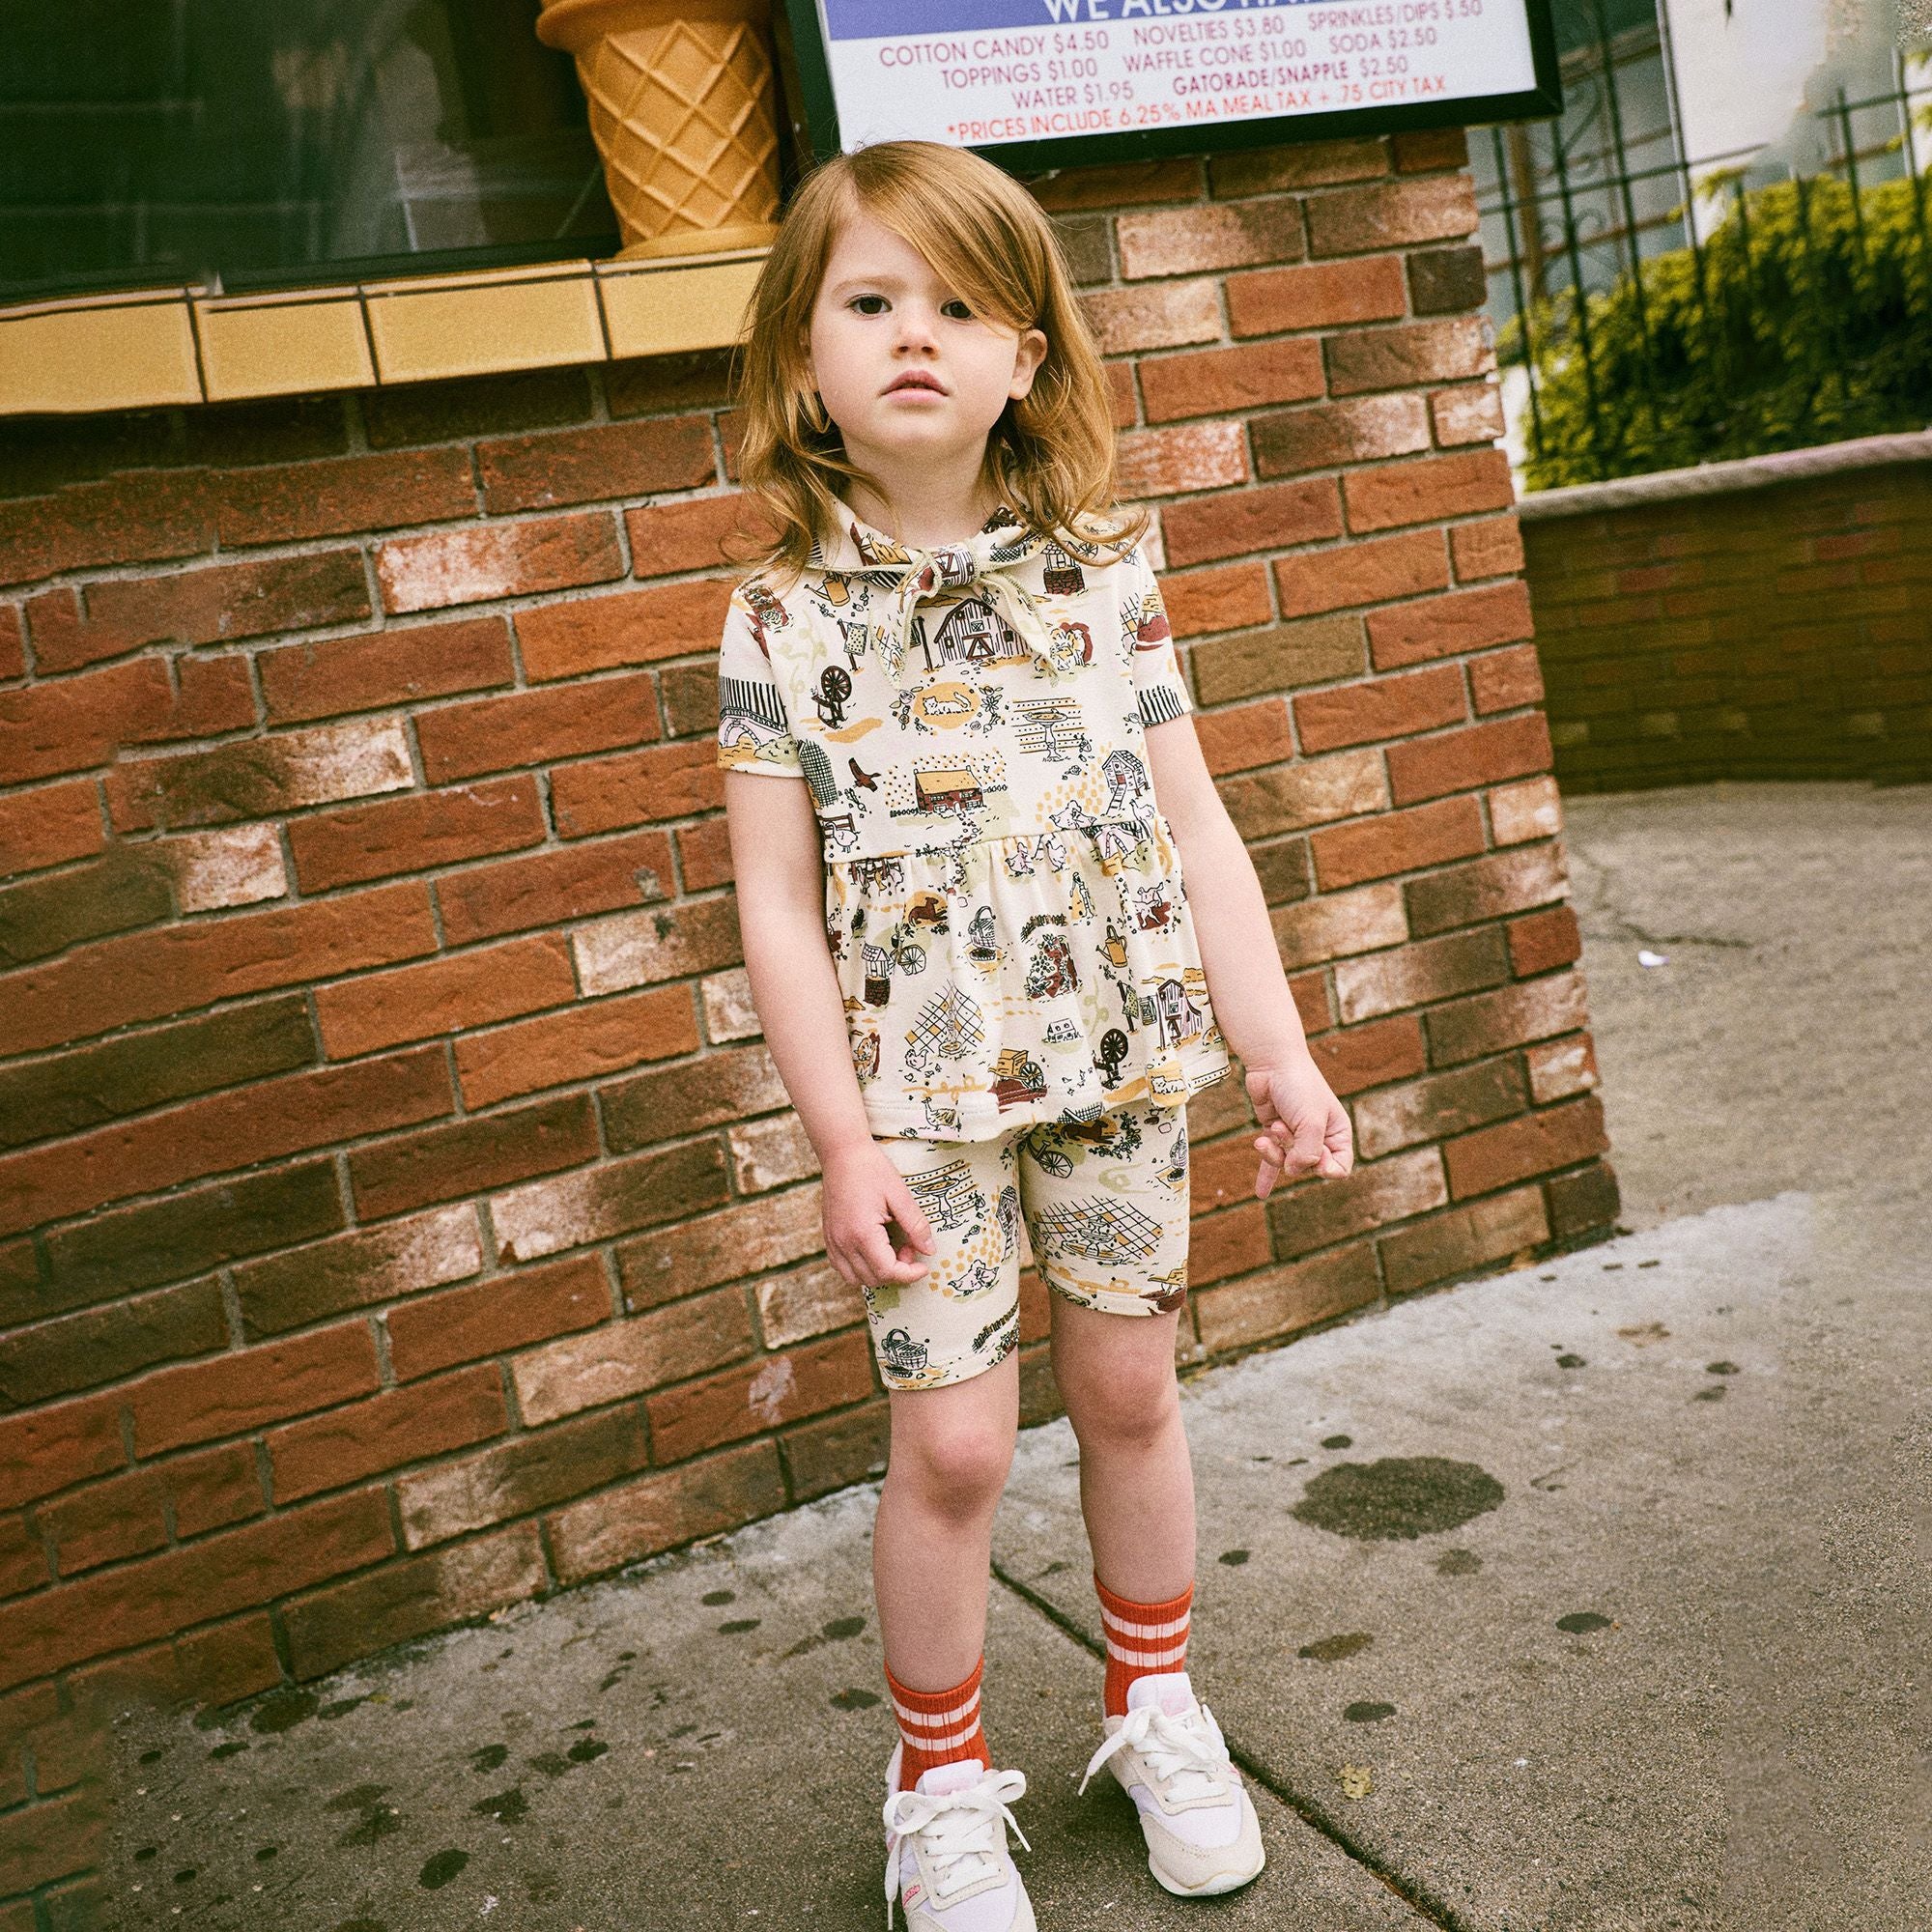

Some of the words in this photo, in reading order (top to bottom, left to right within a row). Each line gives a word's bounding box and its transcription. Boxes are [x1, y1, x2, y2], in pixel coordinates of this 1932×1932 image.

[880, 42, 967, 67] COTTON
[974, 35, 1045, 60] CANDY
[1054, 30, 1109, 54] $4.50
[1133, 19, 1228, 46] NOVELTIES
[941, 63, 1040, 89] TOPPINGS
[1048, 58, 1097, 83] $1.00
[1122, 49, 1194, 72] WAFFLE
[1201, 43, 1254, 67] CONE
[1260, 38, 1306, 63] $1.00
[1329, 33, 1380, 55] SODA
[1388, 26, 1437, 49] $2.50
[1011, 85, 1077, 110] WATER
[1084, 80, 1134, 105] $1.95
[1173, 61, 1349, 96] GATORADE/SNAPPLE
[1359, 55, 1408, 78] $2.50
[1032, 108, 1113, 134] INCLUDE
[1119, 102, 1180, 127] 6.25%
[1186, 99, 1218, 119] MA
[1223, 95, 1273, 115] MEAL
[1276, 89, 1312, 110] TAX
[1369, 79, 1406, 99] CITY
[1412, 74, 1447, 94] TAX
